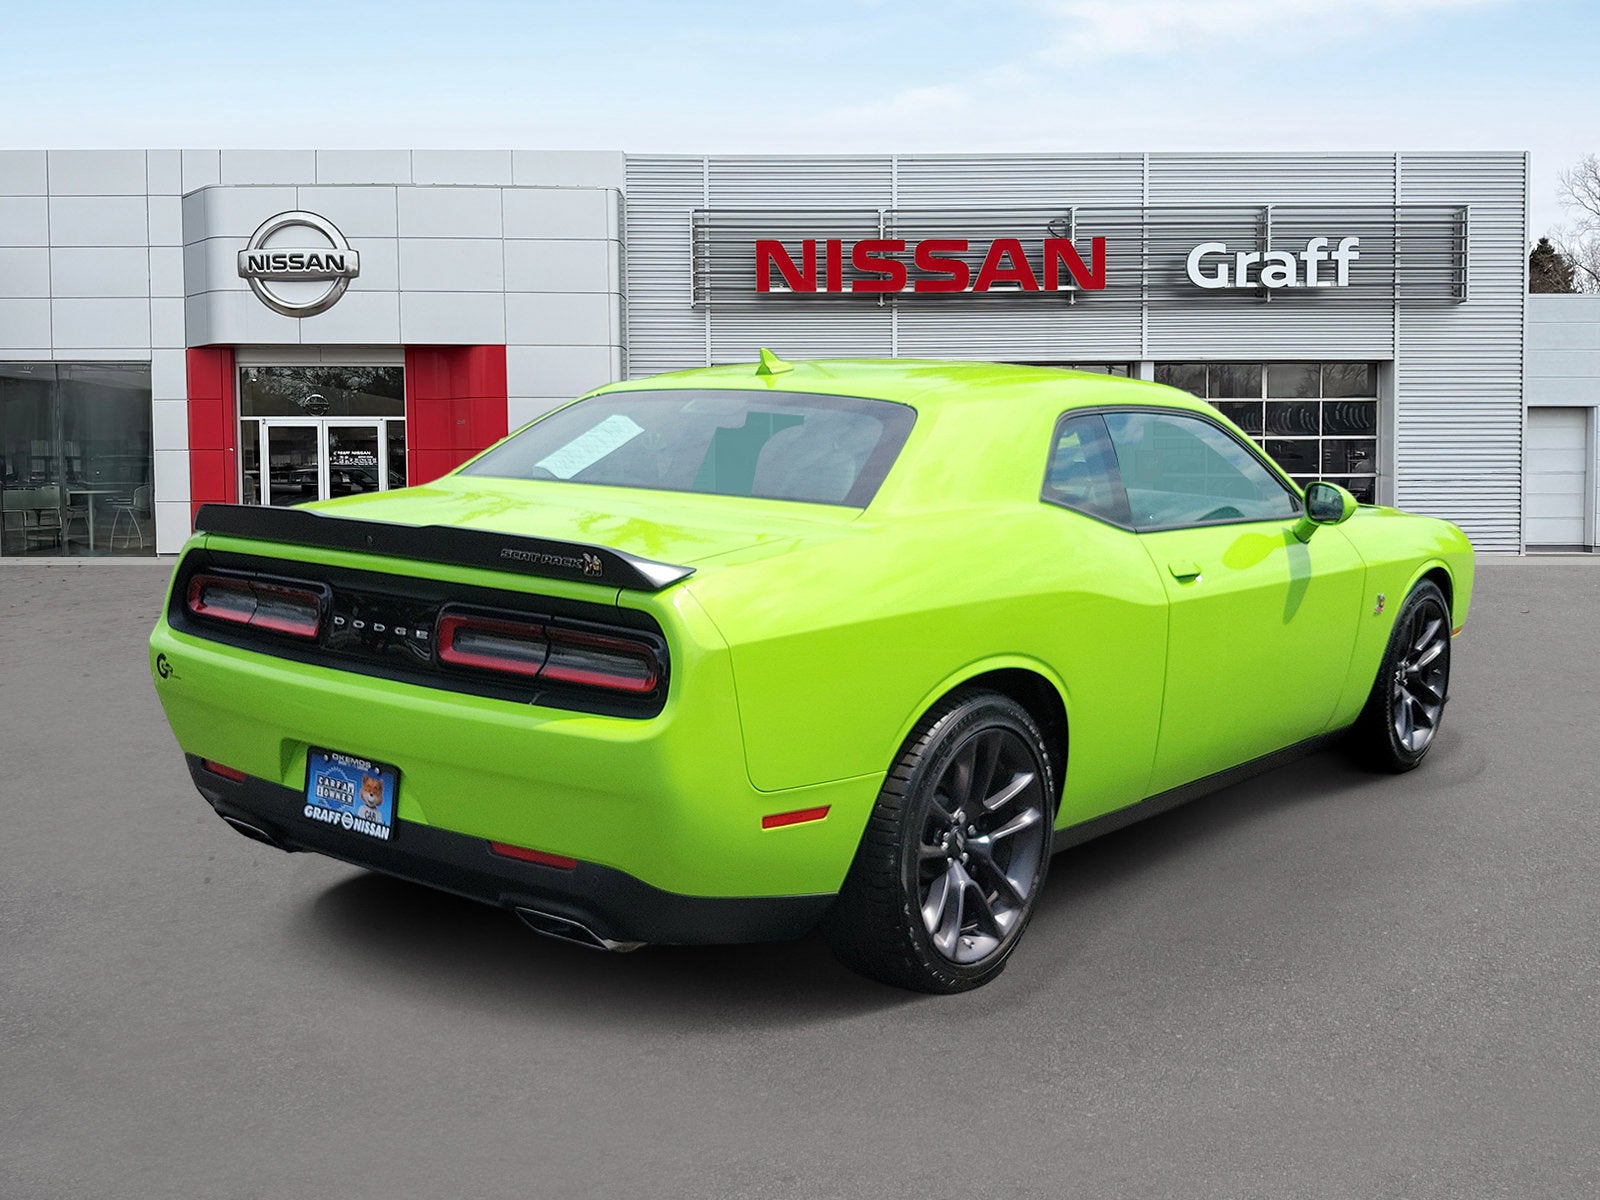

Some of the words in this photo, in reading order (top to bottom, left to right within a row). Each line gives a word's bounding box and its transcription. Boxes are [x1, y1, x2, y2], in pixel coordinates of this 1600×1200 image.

[248, 253, 345, 272] NISSAN
[755, 236, 1106, 293] NISSAN
[1186, 237, 1360, 288] Graff
[500, 548, 541, 563] SCAT
[541, 554, 583, 569] PACK
[334, 616, 429, 639] DODGE
[331, 753, 371, 768] OKEMOS
[304, 805, 341, 825] GRAFF
[353, 818, 390, 840] NISSAN
